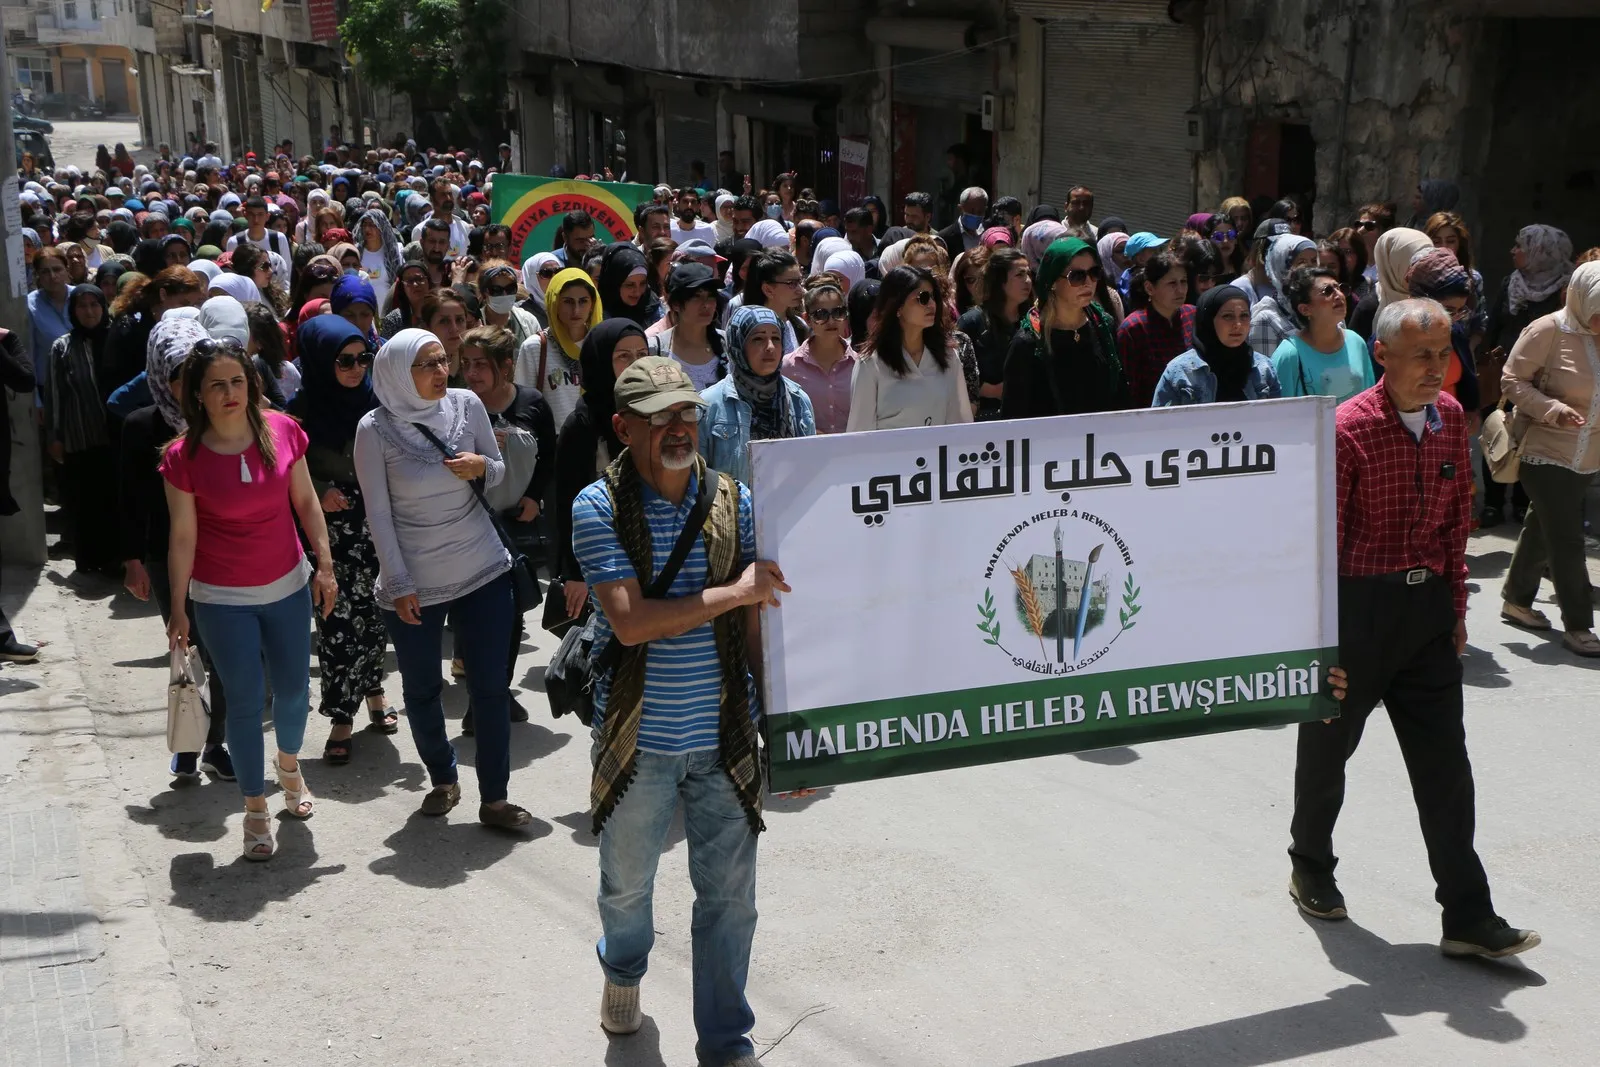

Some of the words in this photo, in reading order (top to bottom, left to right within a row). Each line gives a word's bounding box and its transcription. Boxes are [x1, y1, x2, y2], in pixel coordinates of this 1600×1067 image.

[851, 438, 1031, 526] الثقافي
[1044, 432, 1132, 503] حلب
[1145, 430, 1276, 487] منتدى
[984, 520, 1030, 579] MALBENDA
[1031, 509, 1068, 523] HELEB
[1070, 510, 1078, 518] A
[1081, 511, 1134, 566] REWŞENBÎRÎ
[1012, 657, 1052, 674] الثقافي
[1054, 662, 1075, 676] حلب
[1077, 646, 1110, 670] منتدى
[786, 709, 970, 760] MALBENDA
[980, 693, 1086, 735] HELEB
[1096, 690, 1117, 720] A
[1127, 660, 1320, 715] REWŞENBÎRÎ
